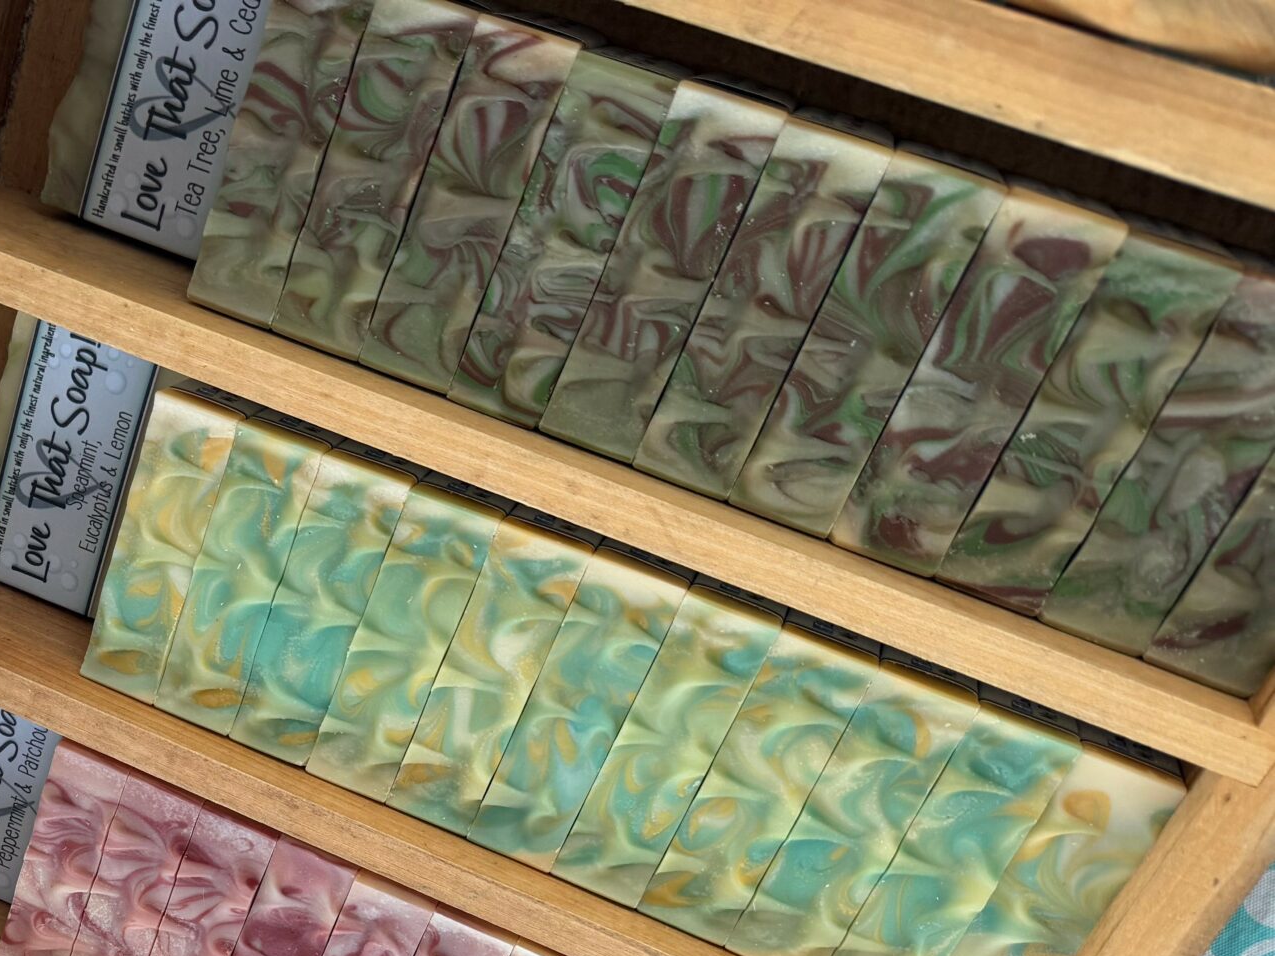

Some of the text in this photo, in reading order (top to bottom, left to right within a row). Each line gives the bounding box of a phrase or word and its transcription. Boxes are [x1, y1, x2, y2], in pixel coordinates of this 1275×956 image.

[142, 46, 197, 141] That
[91, 2, 161, 219] Handcrafted in small batches with only the finest
[174, 47, 247, 216] Tea Tree, Lime &
[120, 157, 168, 232] Love
[32, 363, 47, 394] natural
[23, 394, 38, 417] finest
[19, 418, 34, 432] the
[16, 432, 33, 450] only
[11, 332, 108, 584] Love That Soap!
[13, 450, 25, 467] with
[4, 468, 21, 495] batches
[65, 439, 103, 511] Spearmint,
[78, 410, 134, 554] Eucalyptus & Lemon
[1, 495, 15, 517] small
[13, 782, 33, 794] &
